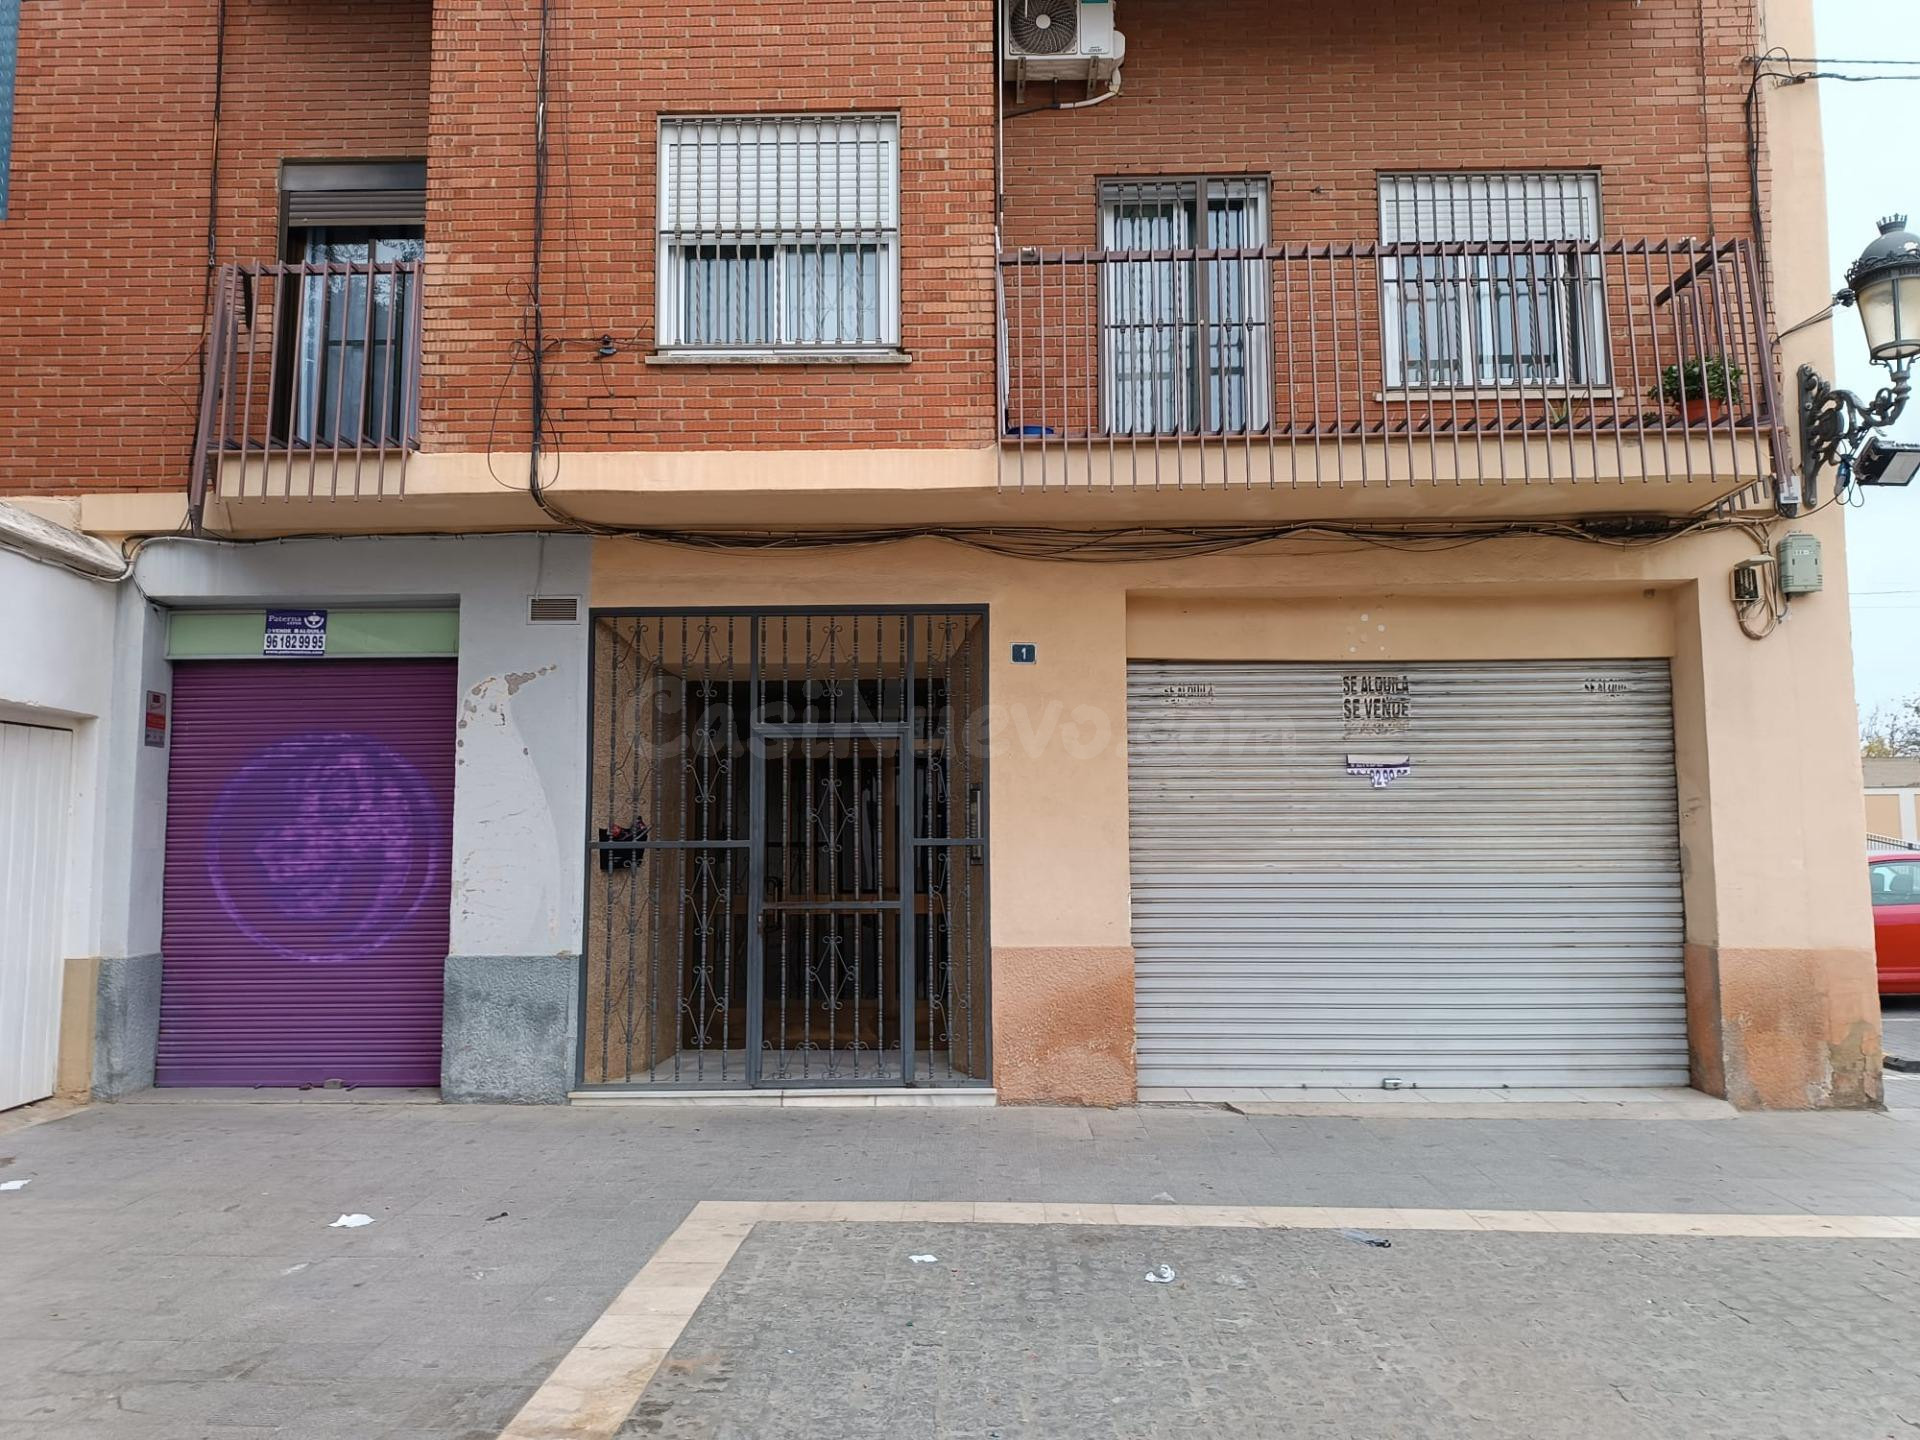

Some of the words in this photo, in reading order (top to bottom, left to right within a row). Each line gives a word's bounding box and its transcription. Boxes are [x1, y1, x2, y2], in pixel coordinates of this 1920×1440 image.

[268, 614, 302, 622] Paterna
[266, 635, 278, 649] 96
[280, 635, 297, 649] 182
[298, 635, 310, 649] 99
[311, 635, 323, 649] 95
[1021, 647, 1027, 660] 1
[1343, 675, 1358, 695] SE
[1361, 675, 1409, 695] ALQUILA
[1343, 698, 1361, 719] SE
[1364, 697, 1409, 719] VENDE
